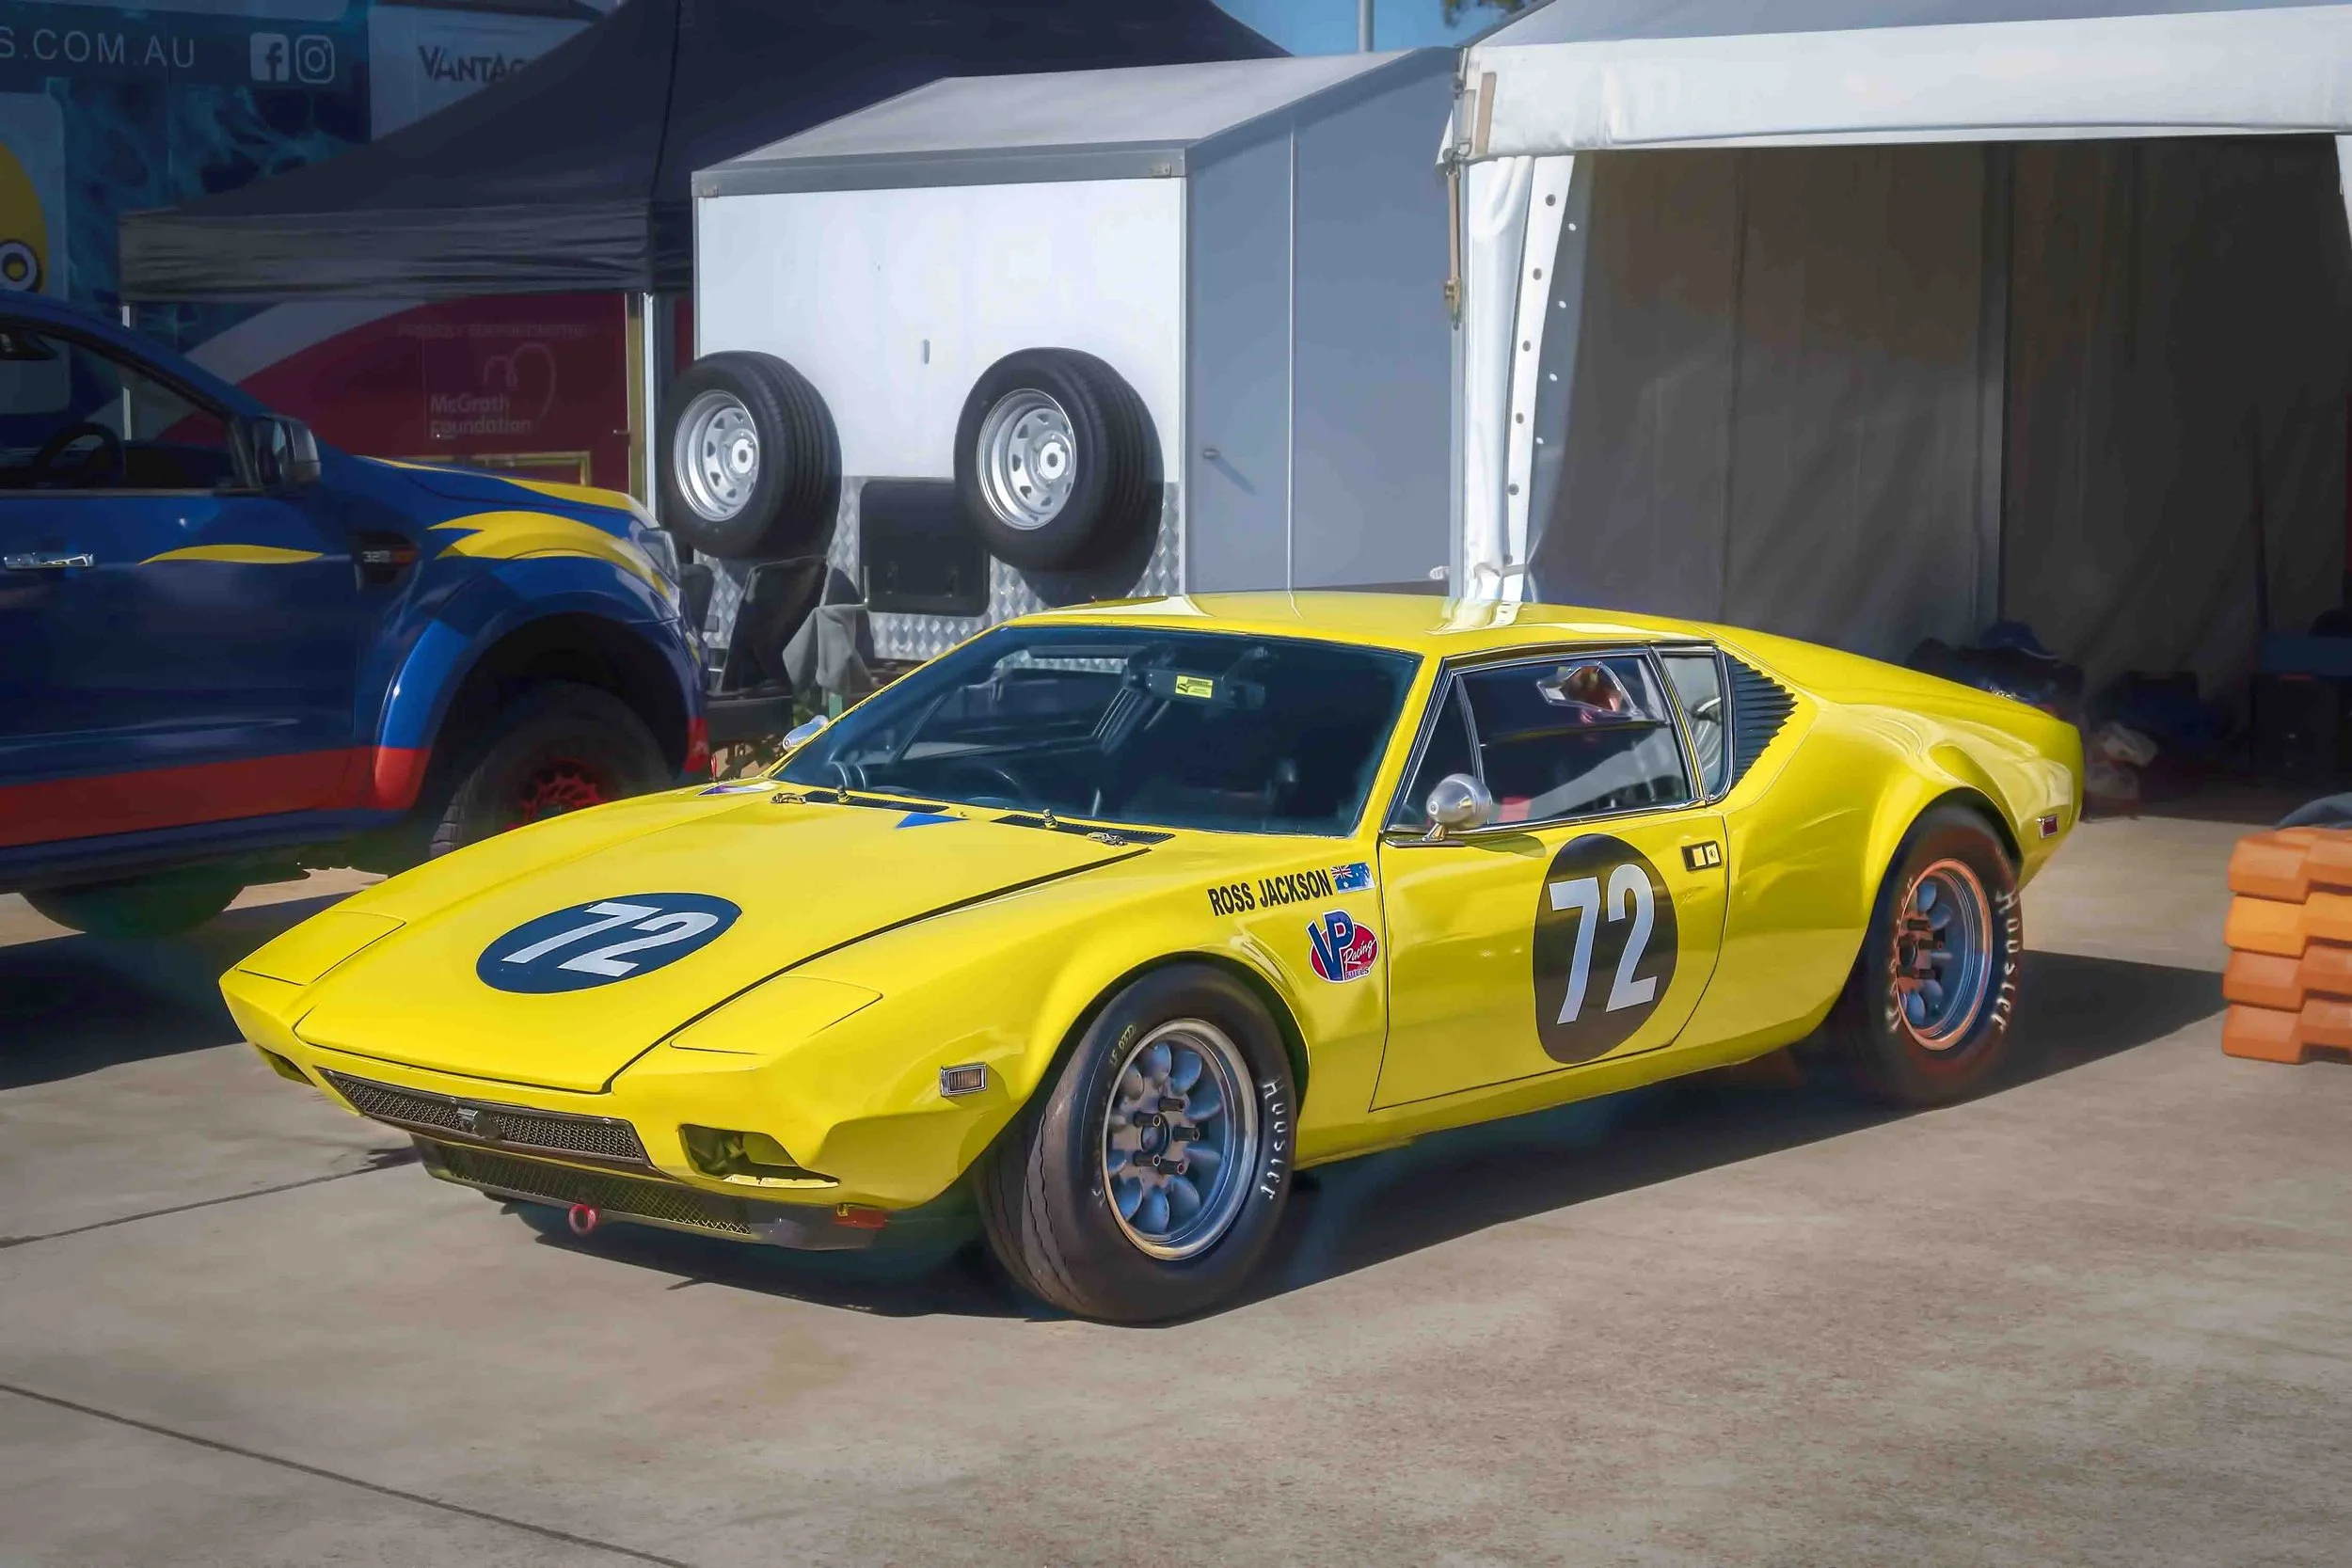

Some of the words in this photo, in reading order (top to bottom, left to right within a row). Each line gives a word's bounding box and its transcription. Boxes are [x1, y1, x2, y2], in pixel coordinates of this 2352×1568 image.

[430, 392, 511, 415] McGrath
[1207, 882, 1256, 917] ROSS
[1259, 868, 1334, 909] JACKSON
[501, 901, 719, 978] 72
[1306, 910, 1356, 982] VP
[1343, 939, 1376, 971] Racing
[1549, 863, 1658, 1025] 72
